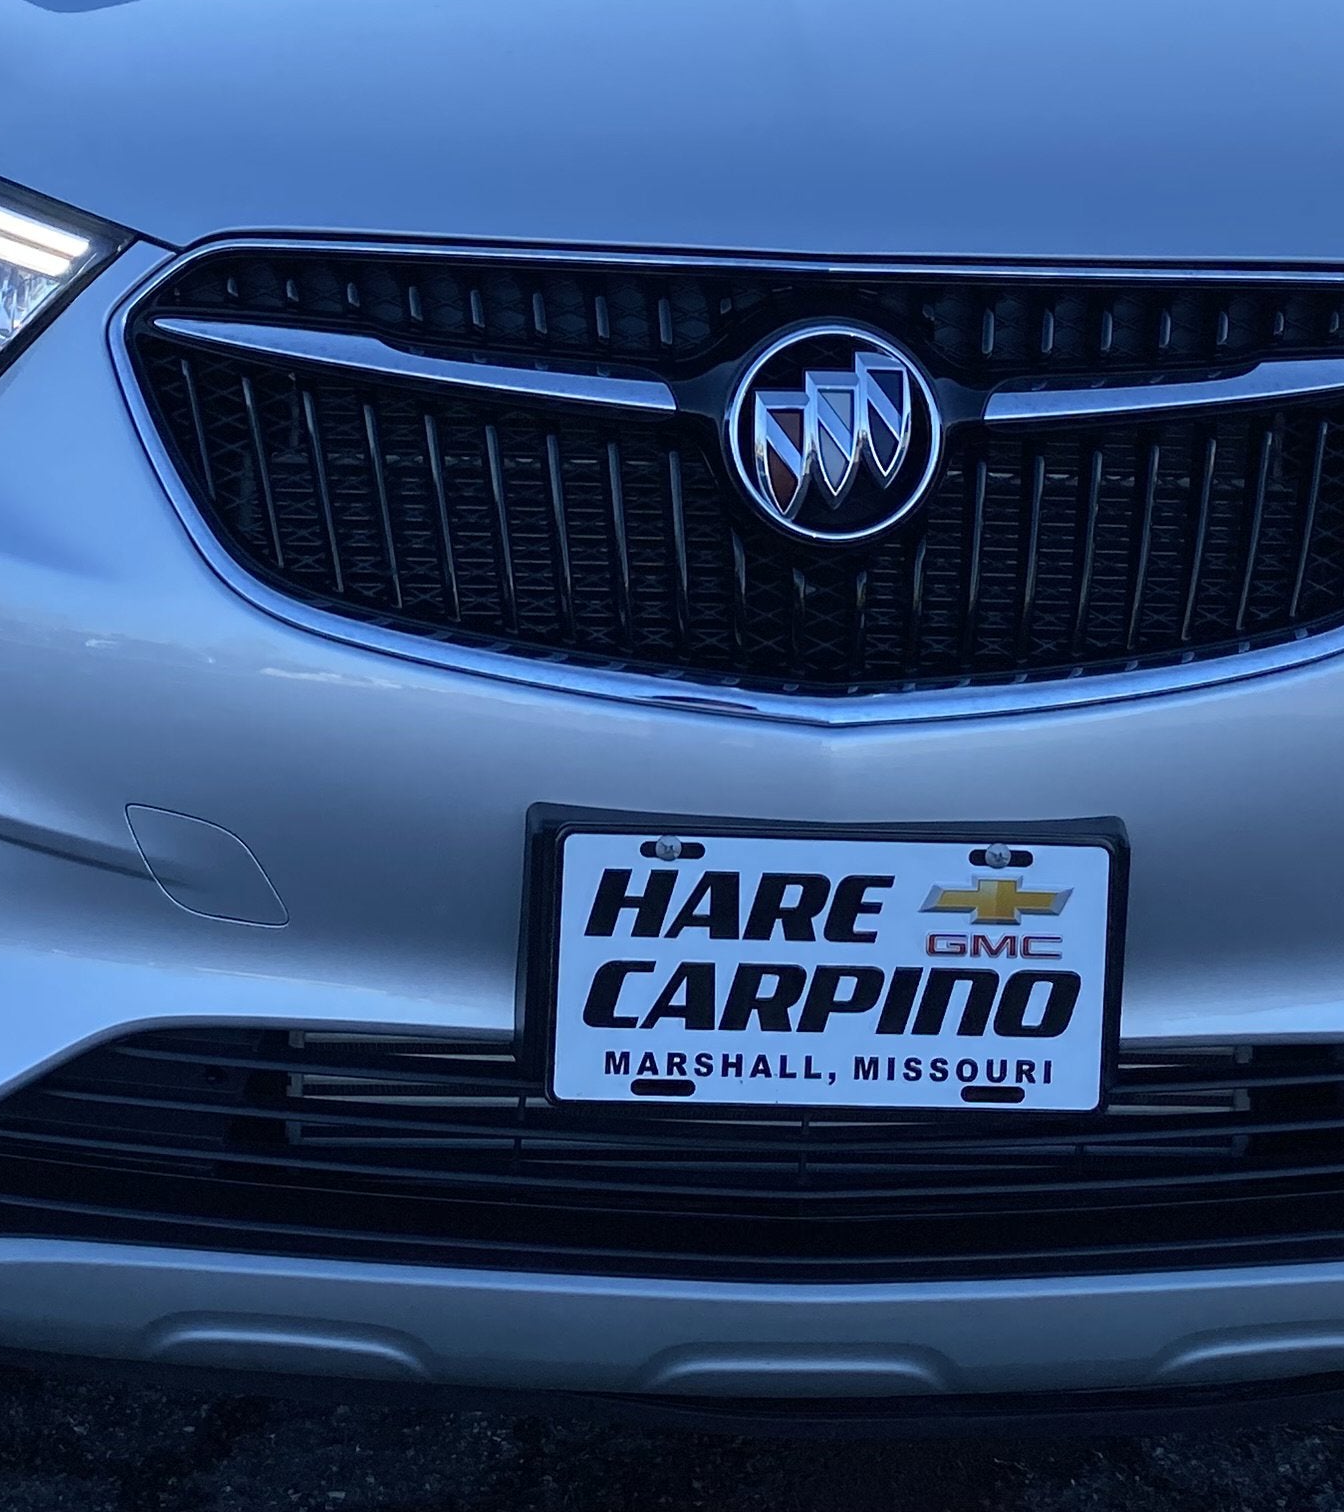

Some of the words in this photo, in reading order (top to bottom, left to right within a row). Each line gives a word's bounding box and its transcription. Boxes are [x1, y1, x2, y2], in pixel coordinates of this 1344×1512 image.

[584, 867, 896, 945] HARE
[924, 933, 1064, 960] GMC
[582, 960, 1083, 1039] CARPINO
[604, 1050, 838, 1085] MARSHALL,
[854, 1055, 1054, 1085] MISSOURI
